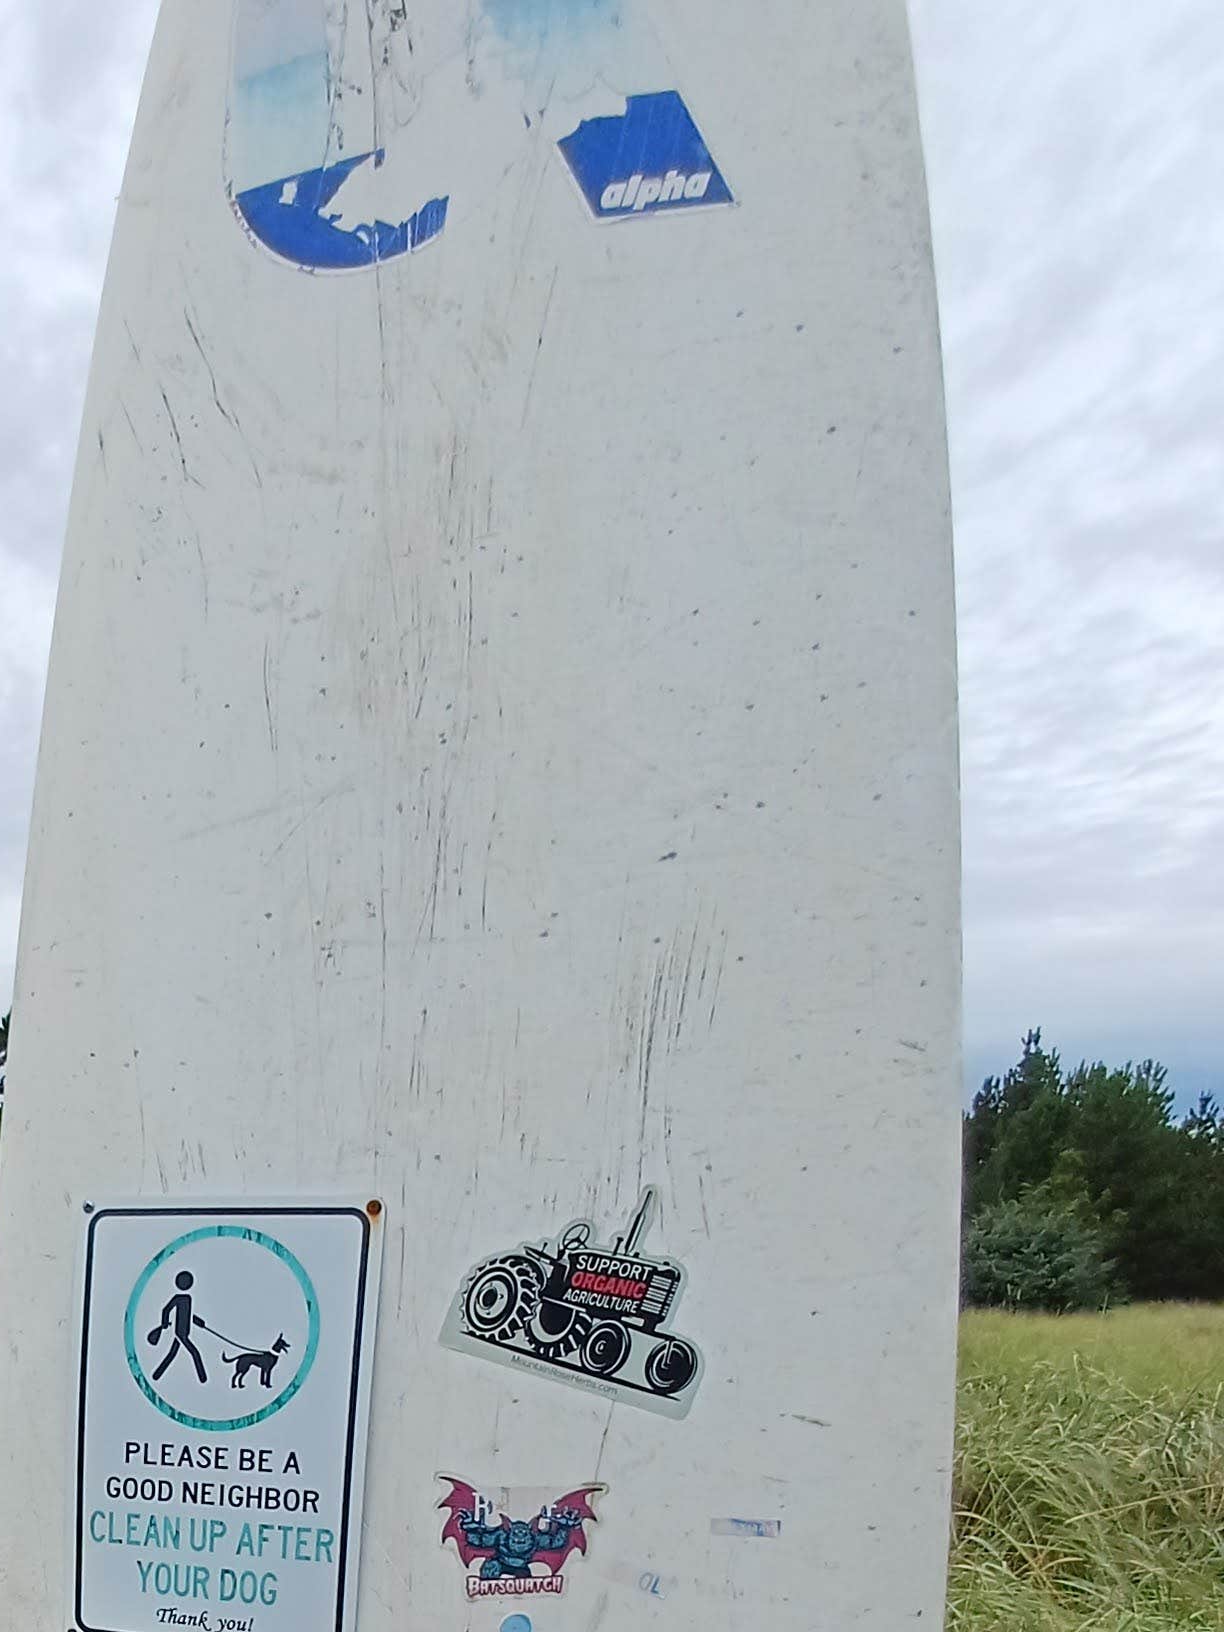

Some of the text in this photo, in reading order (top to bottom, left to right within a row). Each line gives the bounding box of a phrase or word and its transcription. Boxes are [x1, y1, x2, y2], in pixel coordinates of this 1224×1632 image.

[600, 170, 713, 211] alpha
[576, 1255, 653, 1281] SUPPORT
[563, 1288, 640, 1314] AGRICULTURE
[571, 1271, 647, 1299] ORGANIC
[125, 1442, 301, 1475] PLEASE BE A
[106, 1476, 320, 1513] GOOD NEIGHBOR
[89, 1510, 334, 1563] CLEAN UP AFTER
[136, 1560, 278, 1606] YOUR DOG
[156, 1608, 212, 1631] Thank
